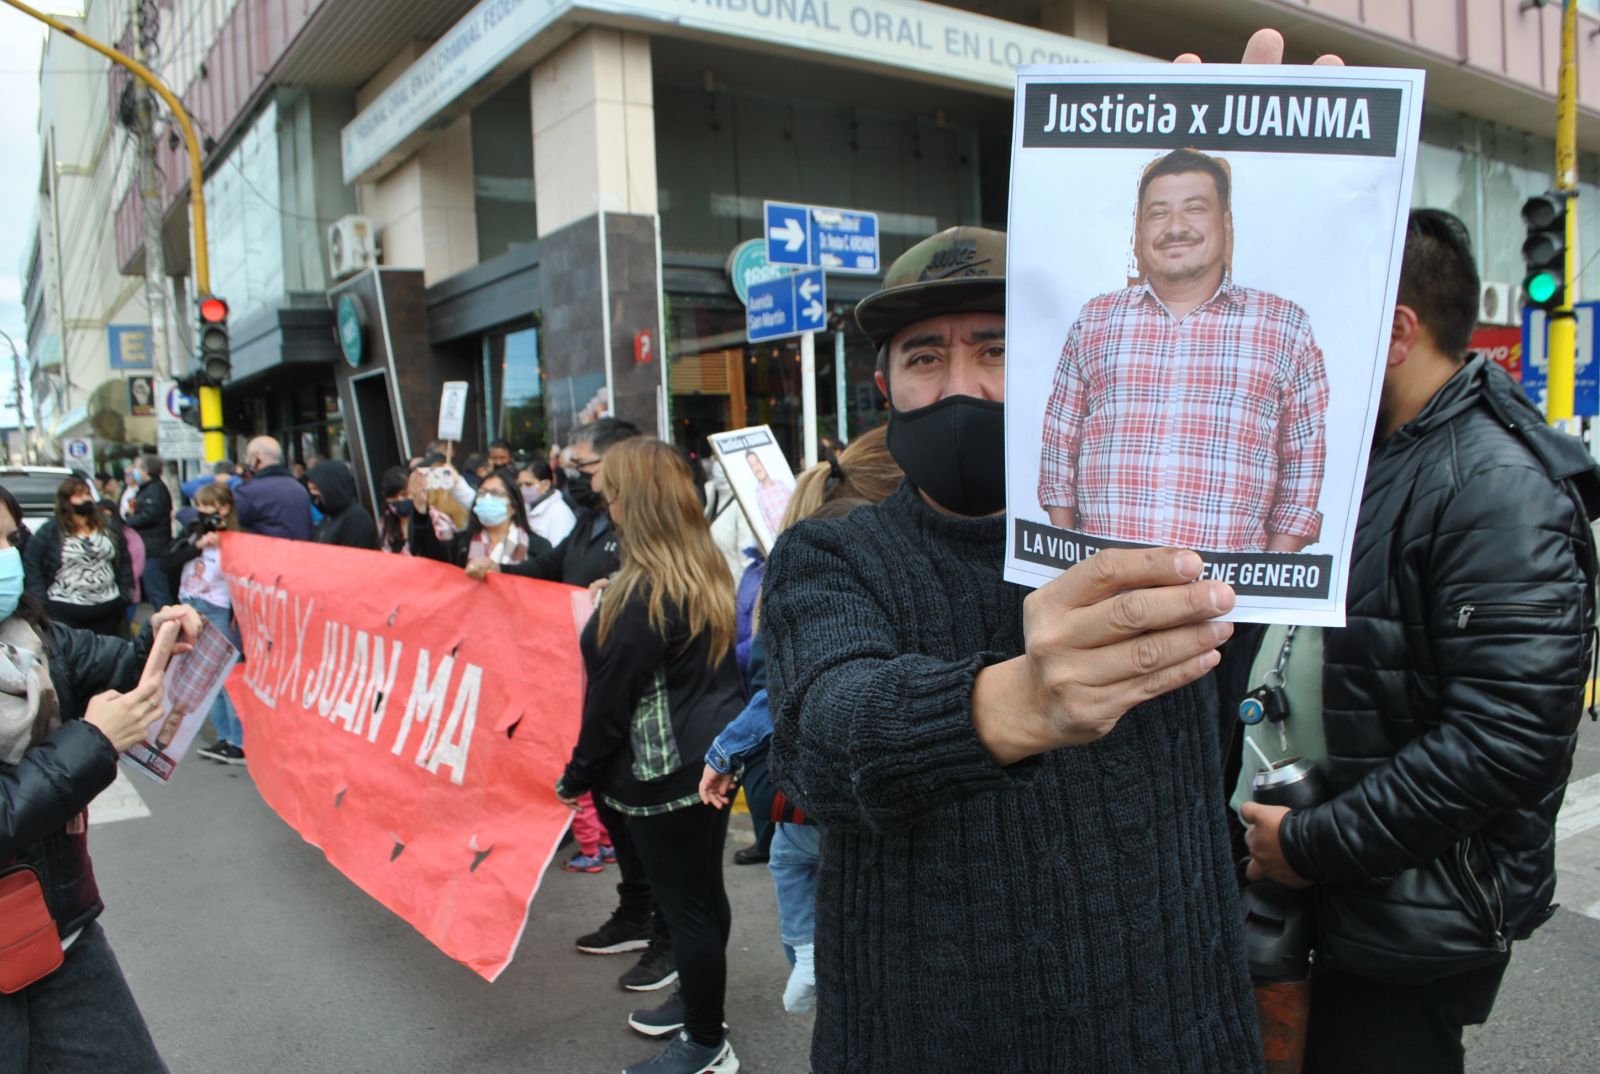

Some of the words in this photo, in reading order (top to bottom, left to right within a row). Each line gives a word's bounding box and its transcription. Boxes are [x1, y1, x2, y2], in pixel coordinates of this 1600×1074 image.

[681, 0, 841, 31] UNAL
[850, 8, 933, 50] ORAL
[944, 28, 981, 60] EN
[988, 37, 1023, 68] LO
[1043, 93, 1177, 134] Justicia
[1188, 104, 1209, 134] x
[1218, 94, 1371, 139] JUANMA
[1023, 530, 1044, 555] LA
[1046, 535, 1100, 563] VIOLE
[1195, 562, 1243, 585] ENE
[1239, 563, 1320, 589] GENERO
[303, 620, 403, 743] JUAN
[391, 648, 483, 785] MA
